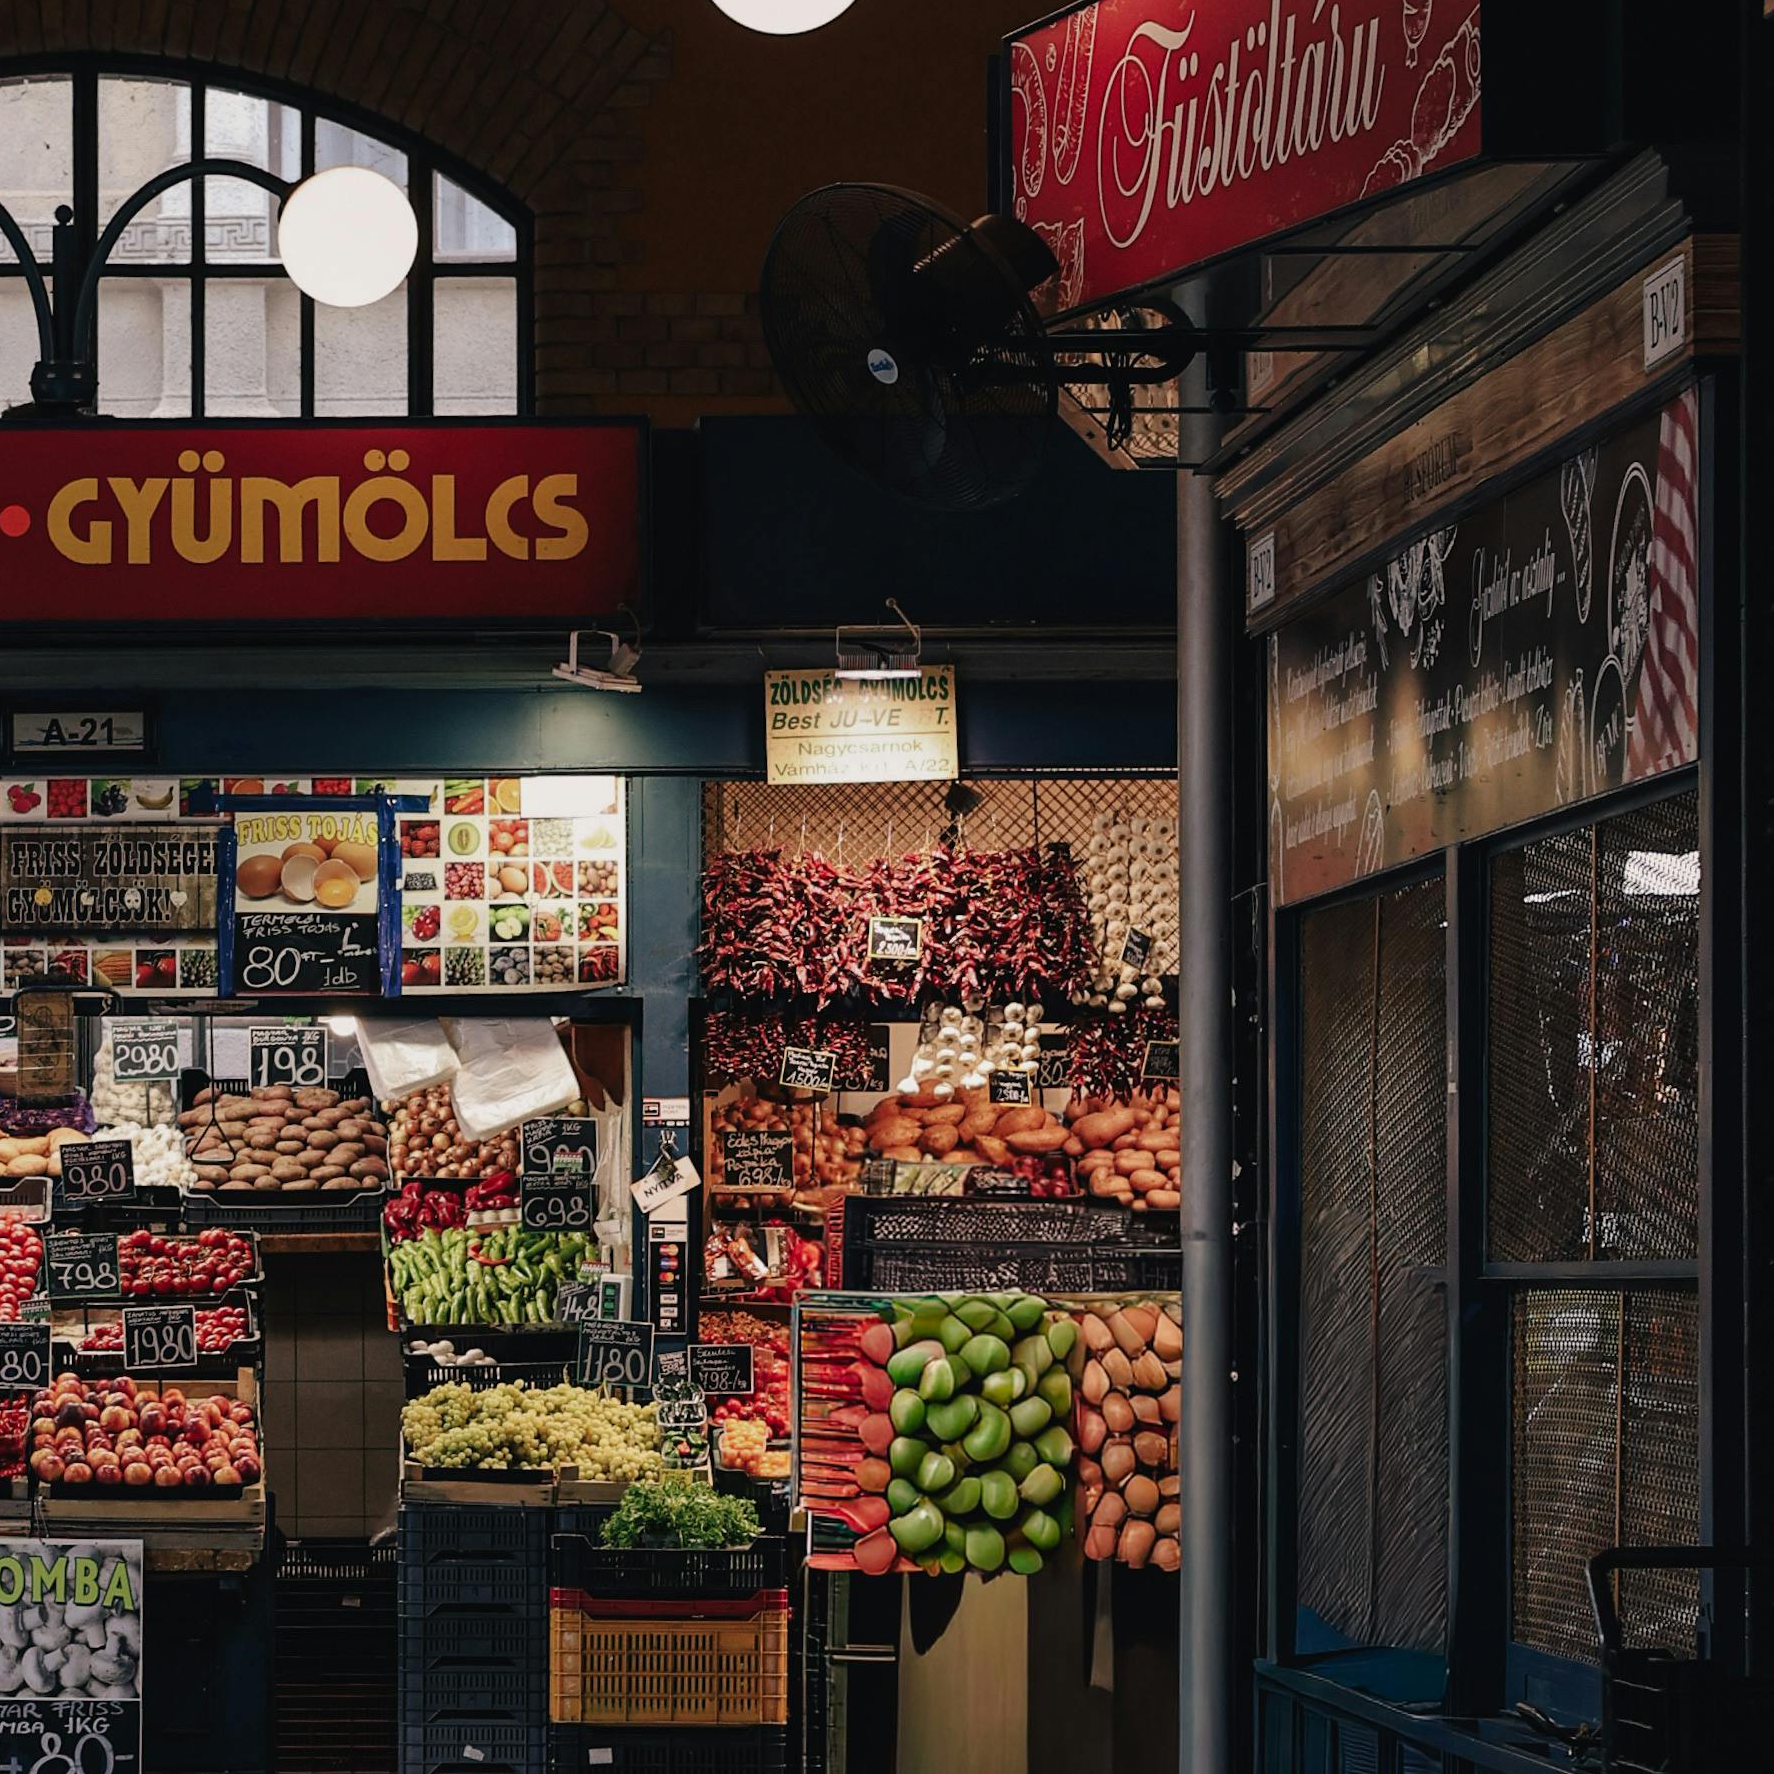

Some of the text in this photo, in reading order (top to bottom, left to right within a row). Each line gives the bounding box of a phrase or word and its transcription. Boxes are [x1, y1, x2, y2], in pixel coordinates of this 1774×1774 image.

[46, 448, 590, 566] GYÜMÖLCS
[42, 717, 114, 746] A-21
[771, 712, 821, 730] Best
[798, 739, 923, 758] Nagycsarnok
[236, 811, 379, 847] FRISS TOJÁS
[11, 842, 84, 876] FRISS
[114, 1044, 177, 1076] 2980
[258, 1046, 324, 1088] 198
[49, 1261, 117, 1290] 798
[131, 1324, 194, 1365] 1980
[584, 1344, 646, 1383] 1180
[50, 1701, 125, 1717] FRISS
[64, 1716, 111, 1734] 1KG
